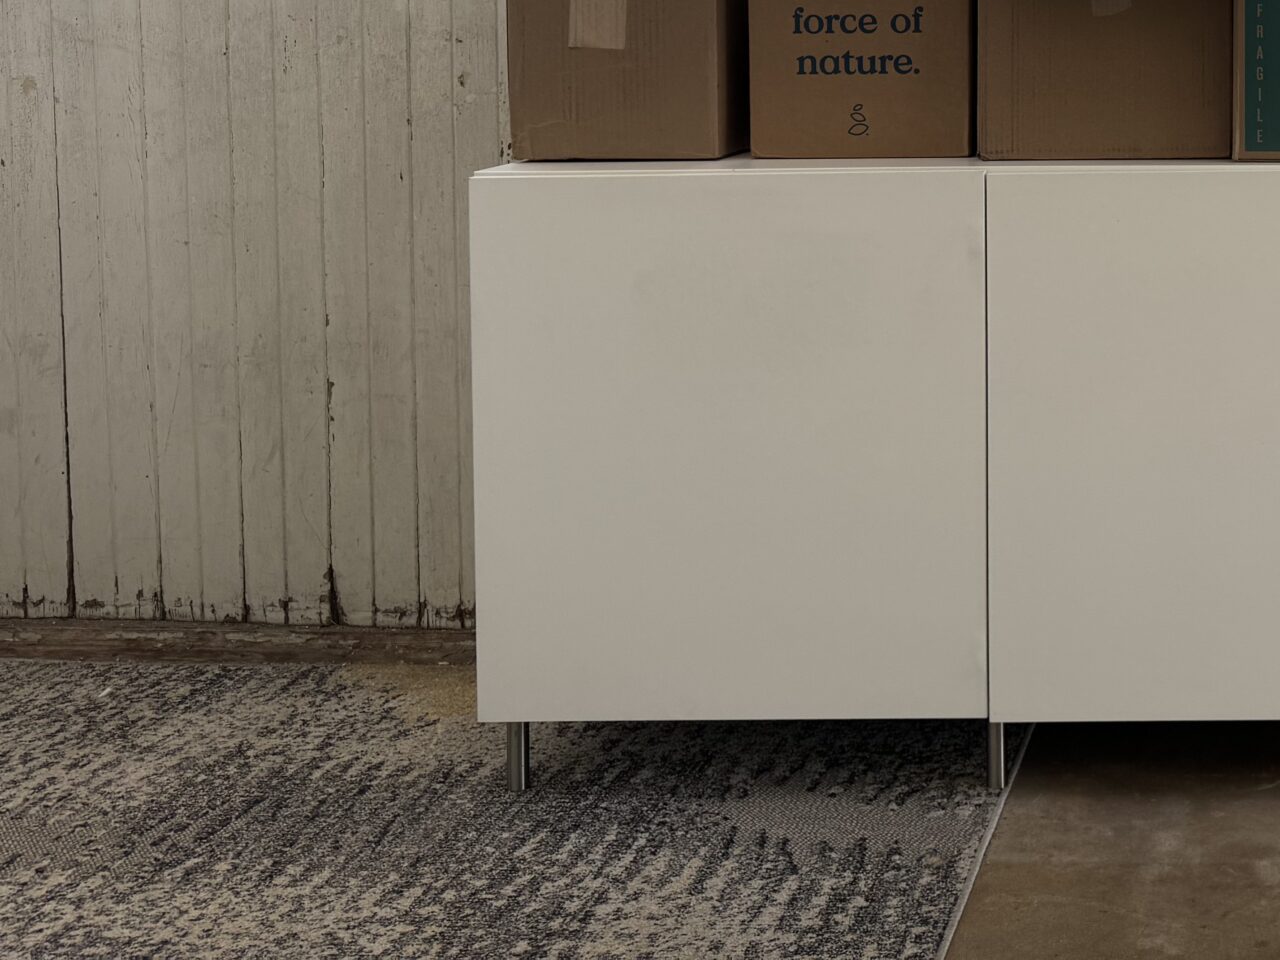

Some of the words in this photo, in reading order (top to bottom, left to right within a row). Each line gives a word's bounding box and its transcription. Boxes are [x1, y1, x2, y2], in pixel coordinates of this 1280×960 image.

[792, 7, 878, 34] force
[890, 6, 924, 34] of
[796, 50, 920, 75] nature.
[1256, 3, 1264, 143] FRAGILE
